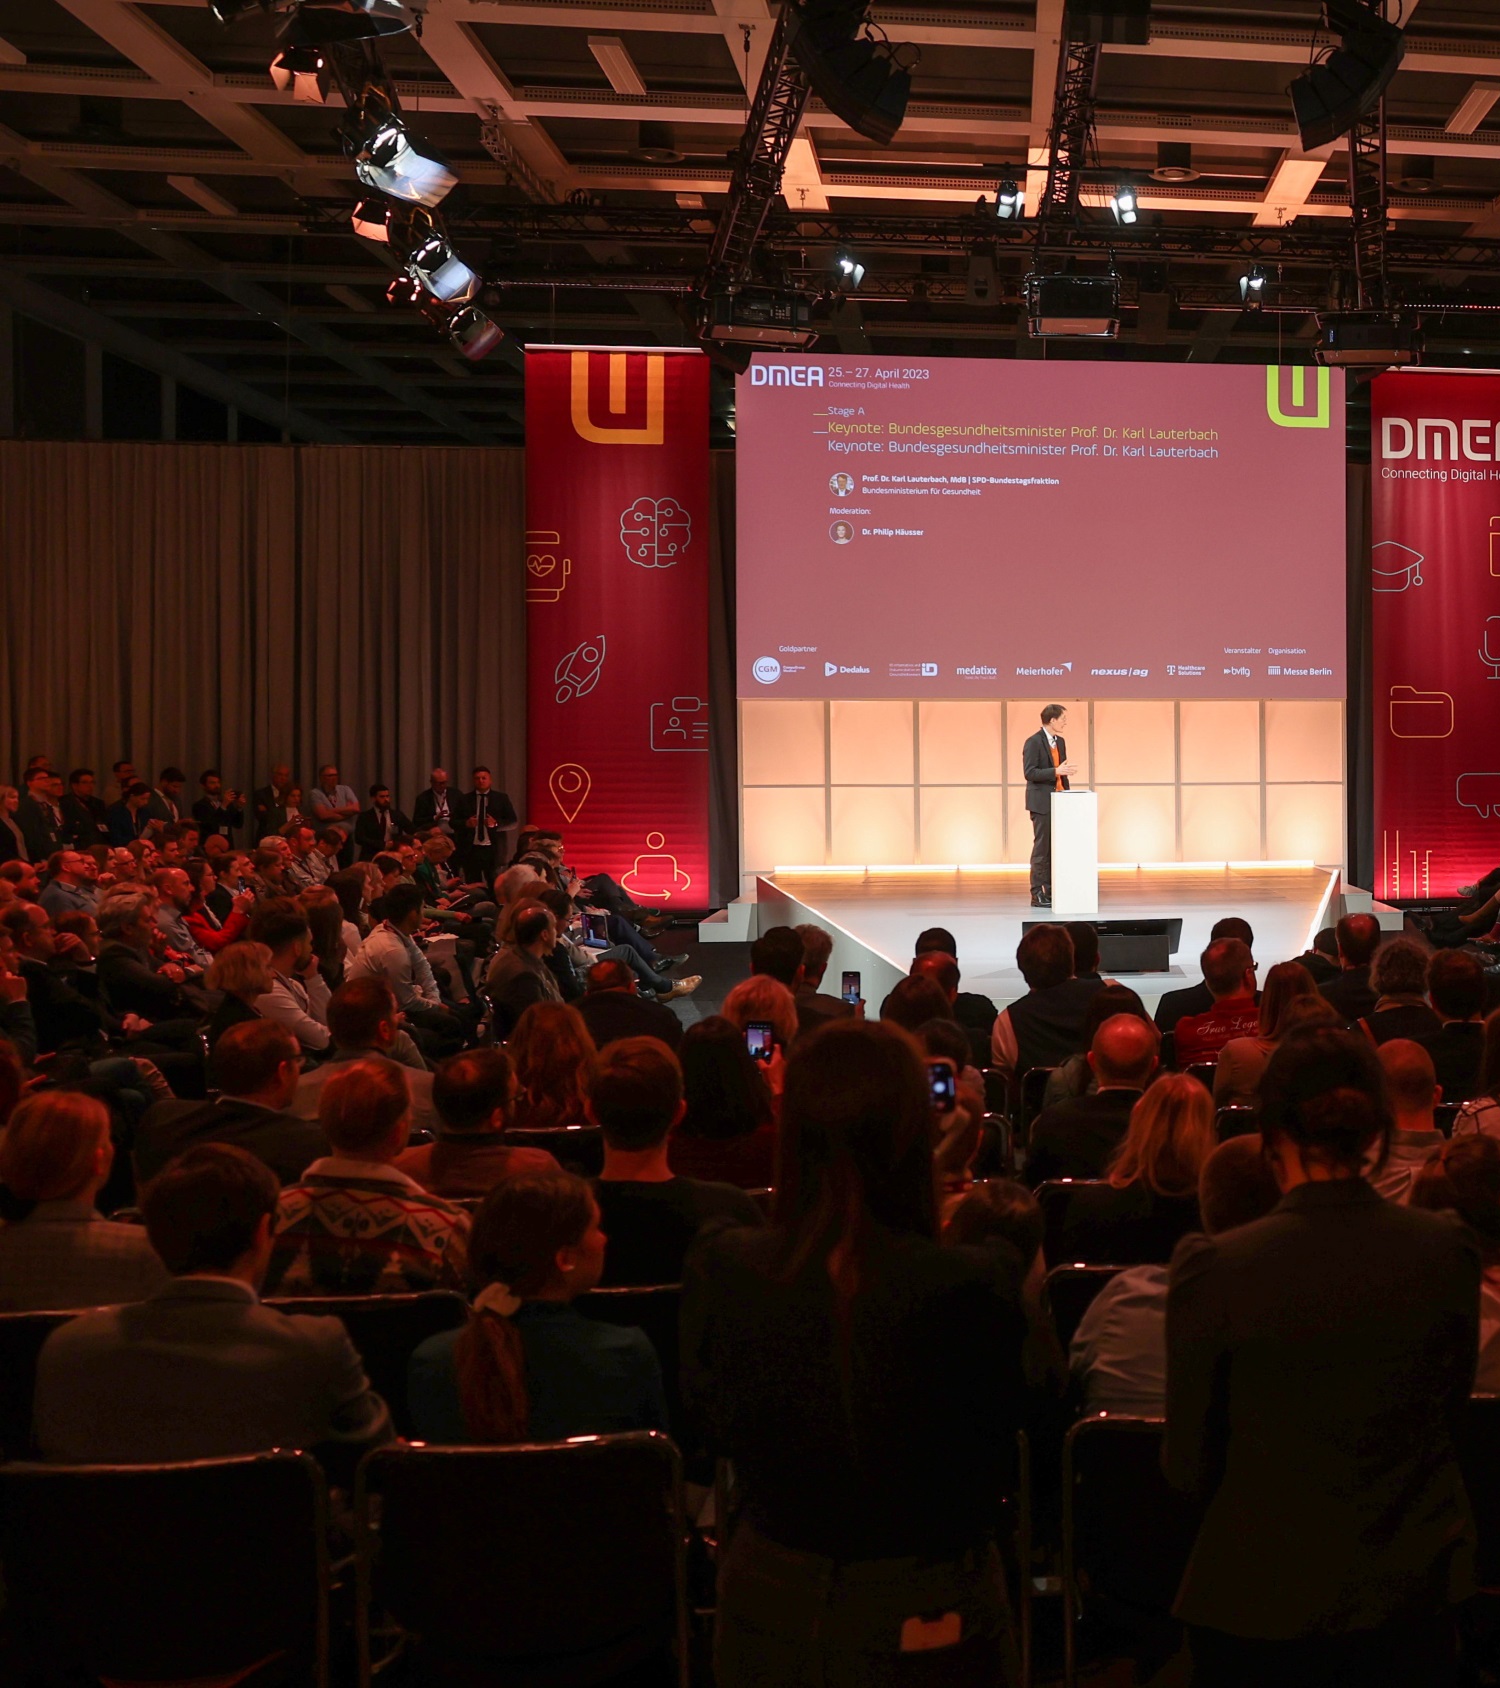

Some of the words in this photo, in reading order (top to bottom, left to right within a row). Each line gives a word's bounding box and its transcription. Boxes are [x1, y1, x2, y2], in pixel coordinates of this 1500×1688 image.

[752, 365, 823, 387] DMEA
[874, 369, 900, 381] April
[902, 369, 930, 380] 2023
[828, 380, 867, 390] Connecting
[866, 381, 888, 390] Digital
[888, 382, 911, 390] Health
[827, 407, 856, 418] Stage
[857, 406, 866, 416] A
[828, 422, 886, 437] Keynote:
[888, 423, 1067, 439] Bundesgesundheitsminister
[1070, 426, 1099, 438] Prof.
[1103, 427, 1118, 439] Dr.
[1122, 427, 1146, 439] Karl
[1149, 428, 1219, 441] Lauterbach
[828, 440, 886, 455] Keynote:
[888, 441, 1067, 457] Bundesgesundheitsminister
[1070, 444, 1099, 456] Prof.
[1103, 445, 1118, 457] Dr.
[1122, 445, 1146, 457] Karl
[1149, 446, 1219, 459] Lauterbach
[861, 474, 880, 482] Prof.
[880, 475, 891, 483] Dr.
[891, 475, 907, 483] Karl
[971, 477, 1060, 487] SPD-Bundestagsfraktion
[1380, 467, 1449, 484] Connecting
[1449, 468, 1488, 484] Digital
[861, 486, 929, 495] Bundesministerium
[929, 487, 941, 495] für
[941, 487, 982, 496] Gesundheit
[829, 507, 872, 515] Moderation:
[861, 528, 872, 536] Dr.
[873, 529, 893, 537] Philip
[894, 528, 924, 536] Häusser
[778, 645, 818, 654] Goldpartner
[1223, 647, 1262, 655] Veranstalter
[1267, 647, 1307, 656] Organisation
[757, 665, 779, 674] CGM
[839, 665, 871, 674] Dedalus
[956, 665, 998, 675] medatixx
[1016, 664, 1064, 676] Meierhofer
[1283, 667, 1309, 676] Messe
[1309, 667, 1333, 676] Berlin
[1230, 1016, 1259, 1034] Lege
